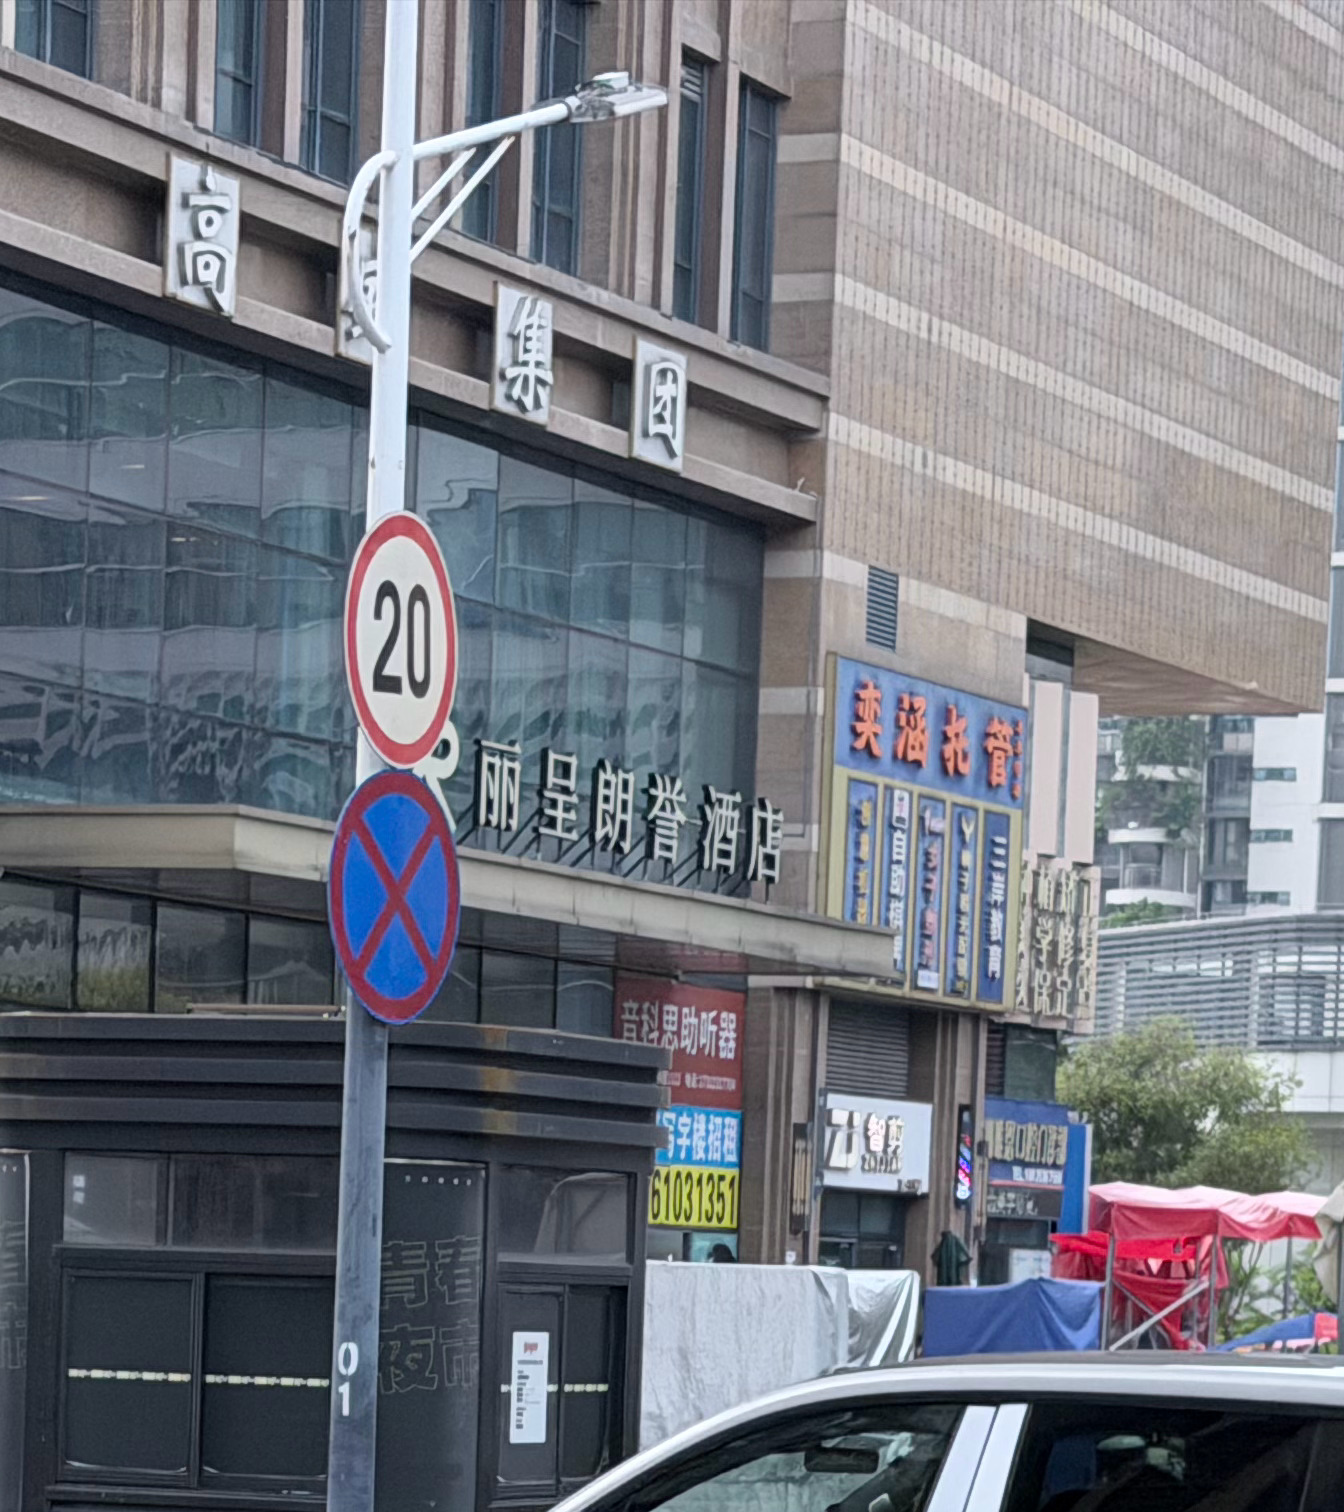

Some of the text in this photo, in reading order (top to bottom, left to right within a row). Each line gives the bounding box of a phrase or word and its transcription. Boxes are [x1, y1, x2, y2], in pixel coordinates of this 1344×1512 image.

[372, 580, 432, 700] 20
[475, 738, 784, 885] 丽呈朗誉酒店
[656, 1111, 739, 1163] 写字楼招租
